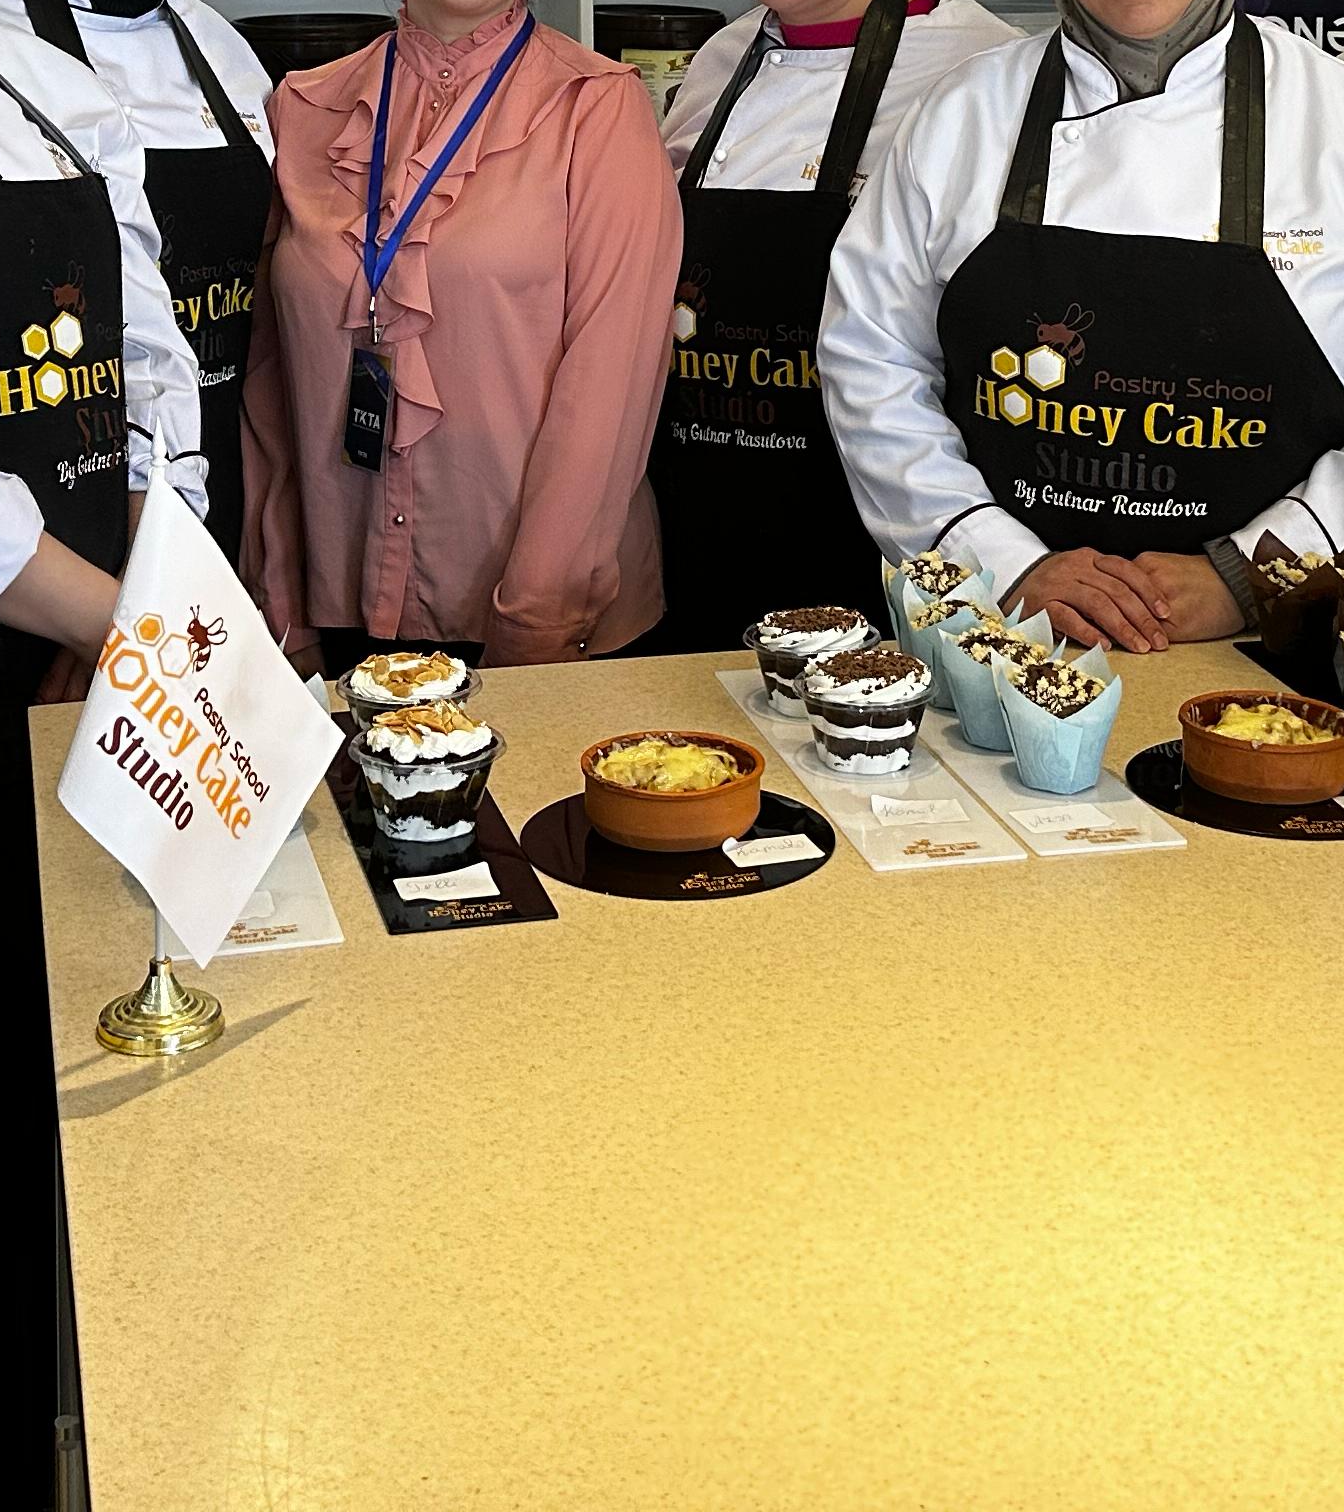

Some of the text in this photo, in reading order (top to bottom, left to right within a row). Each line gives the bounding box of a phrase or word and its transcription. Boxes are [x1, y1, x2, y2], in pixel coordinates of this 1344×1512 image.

[669, 348, 739, 389] ney
[1094, 370, 1272, 402] Pastry School
[690, 423, 731, 445] Gulnar
[735, 428, 807, 449] Rasulova
[973, 374, 1267, 450] Honey Cake
[1035, 441, 1177, 493] Studio
[1014, 479, 1208, 517] By Gulnar Rasulova
[194, 687, 270, 802] Pastry School
[96, 716, 194, 831] Studio
[196, 741, 252, 840] Cake
